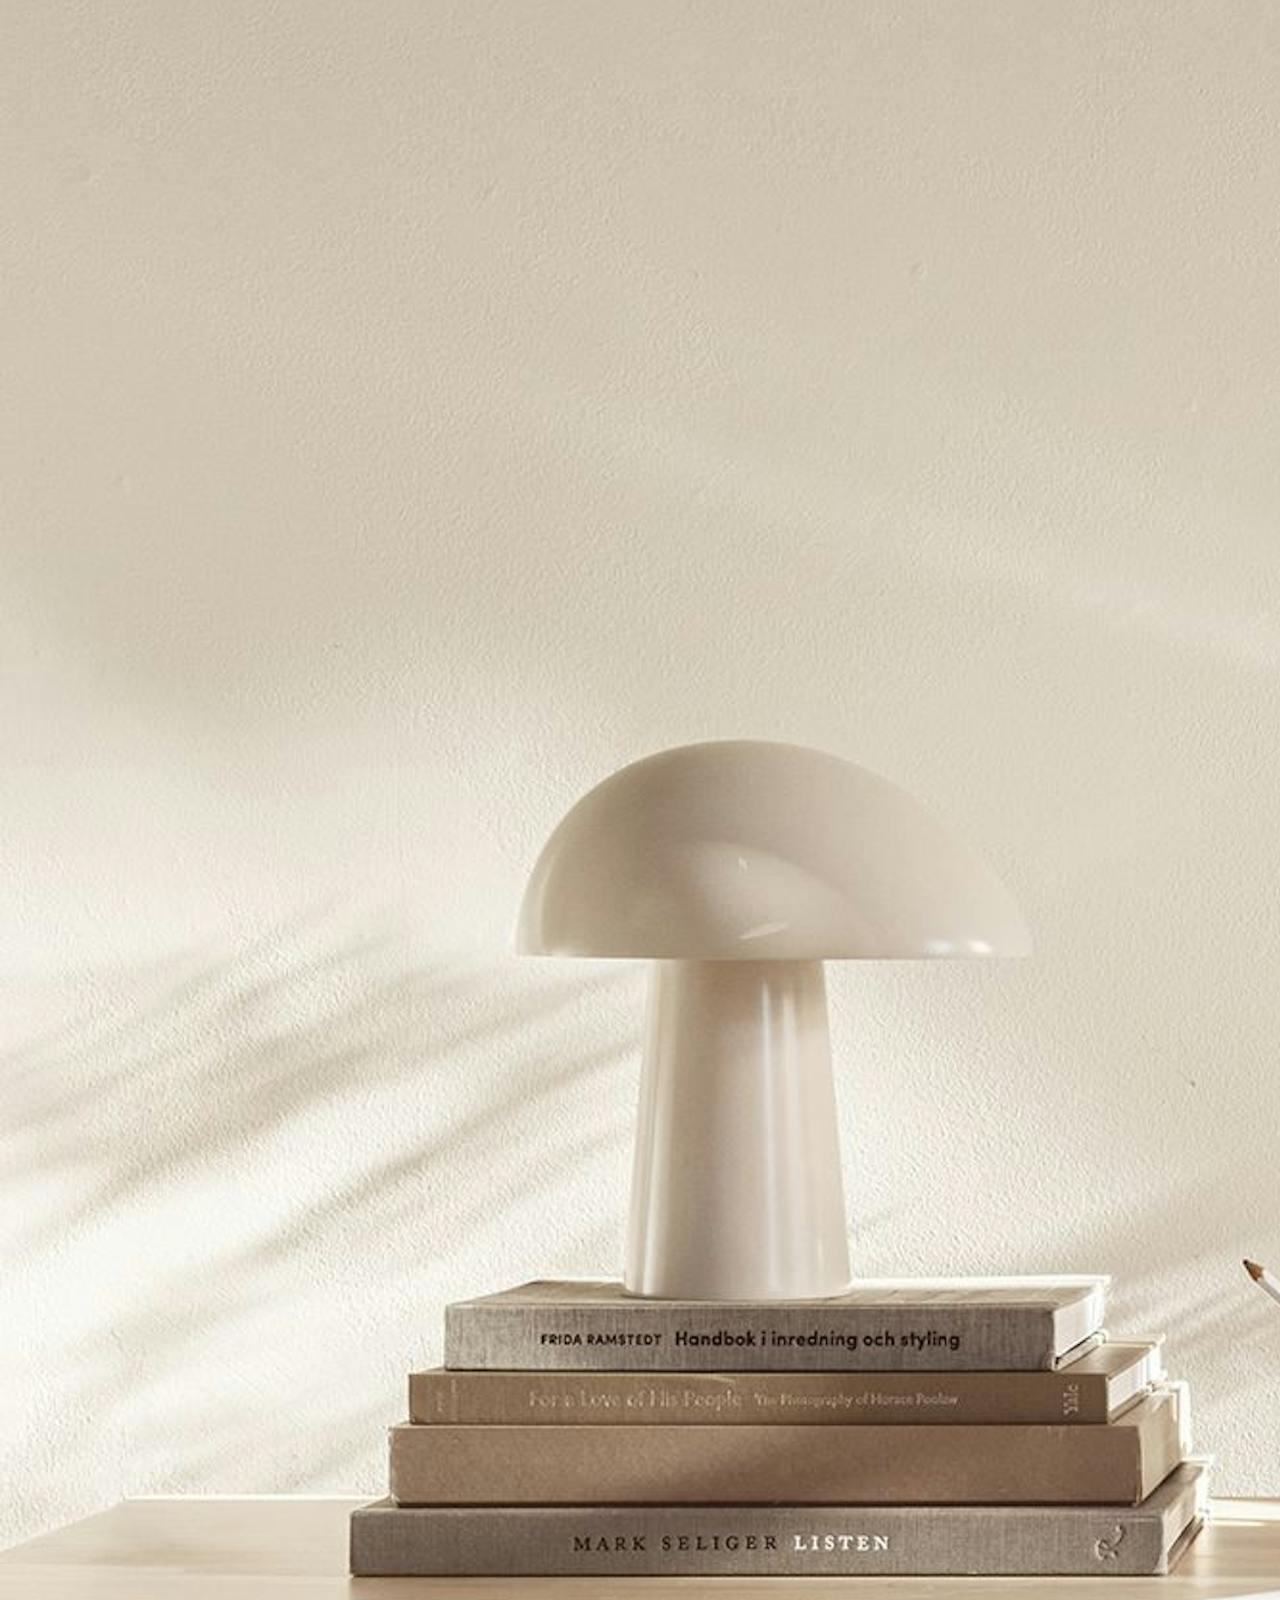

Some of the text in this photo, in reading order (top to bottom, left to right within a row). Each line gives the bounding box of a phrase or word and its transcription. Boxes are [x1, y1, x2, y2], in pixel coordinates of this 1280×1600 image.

[540, 1331, 960, 1350] FRIDA RAMSTEDT Handbok i inredning och styling
[573, 1535, 890, 1551] MARK SELIGER LISTEN
